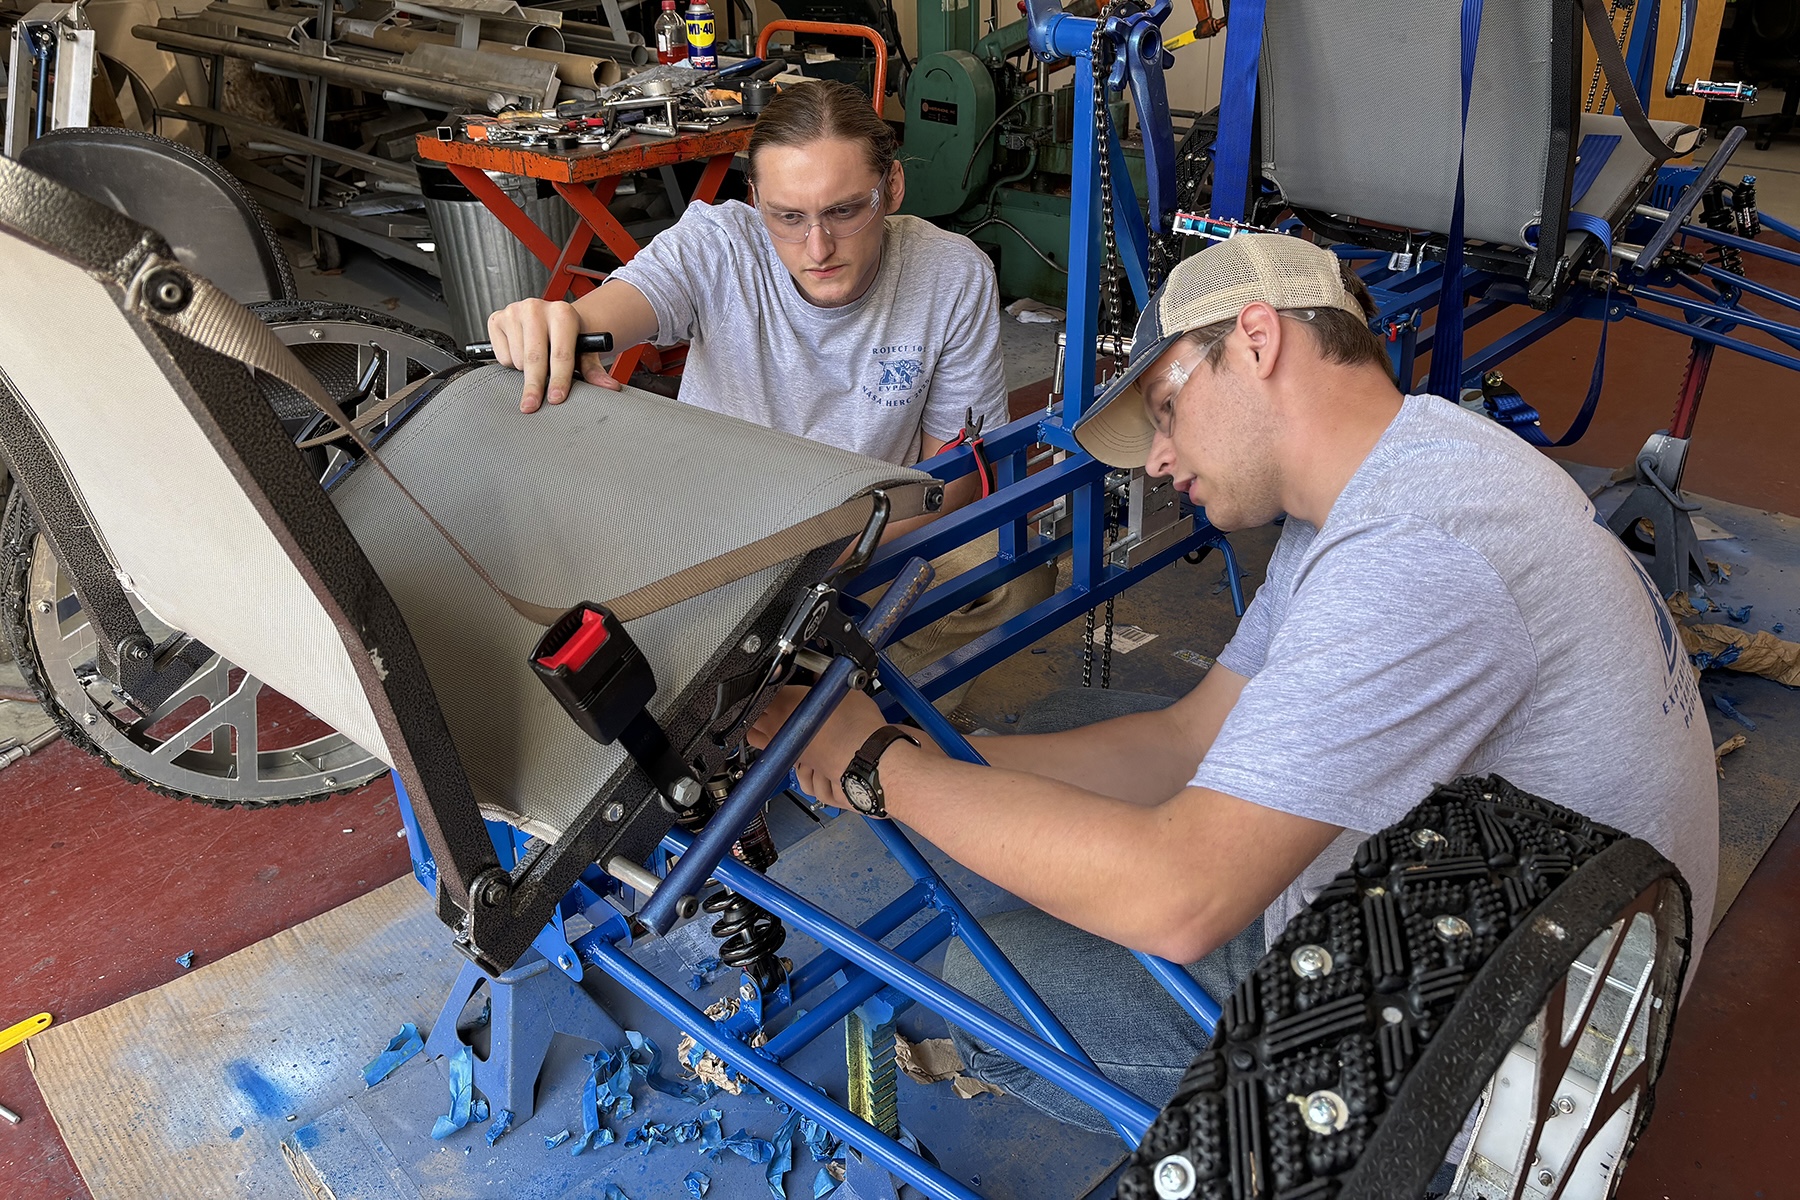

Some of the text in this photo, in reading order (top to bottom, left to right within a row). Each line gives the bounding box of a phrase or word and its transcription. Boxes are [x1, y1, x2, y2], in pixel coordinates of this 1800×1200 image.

[687, 22, 714, 35] WD-40
[872, 345, 909, 355] ROJECT
[886, 397, 912, 407] HERC
